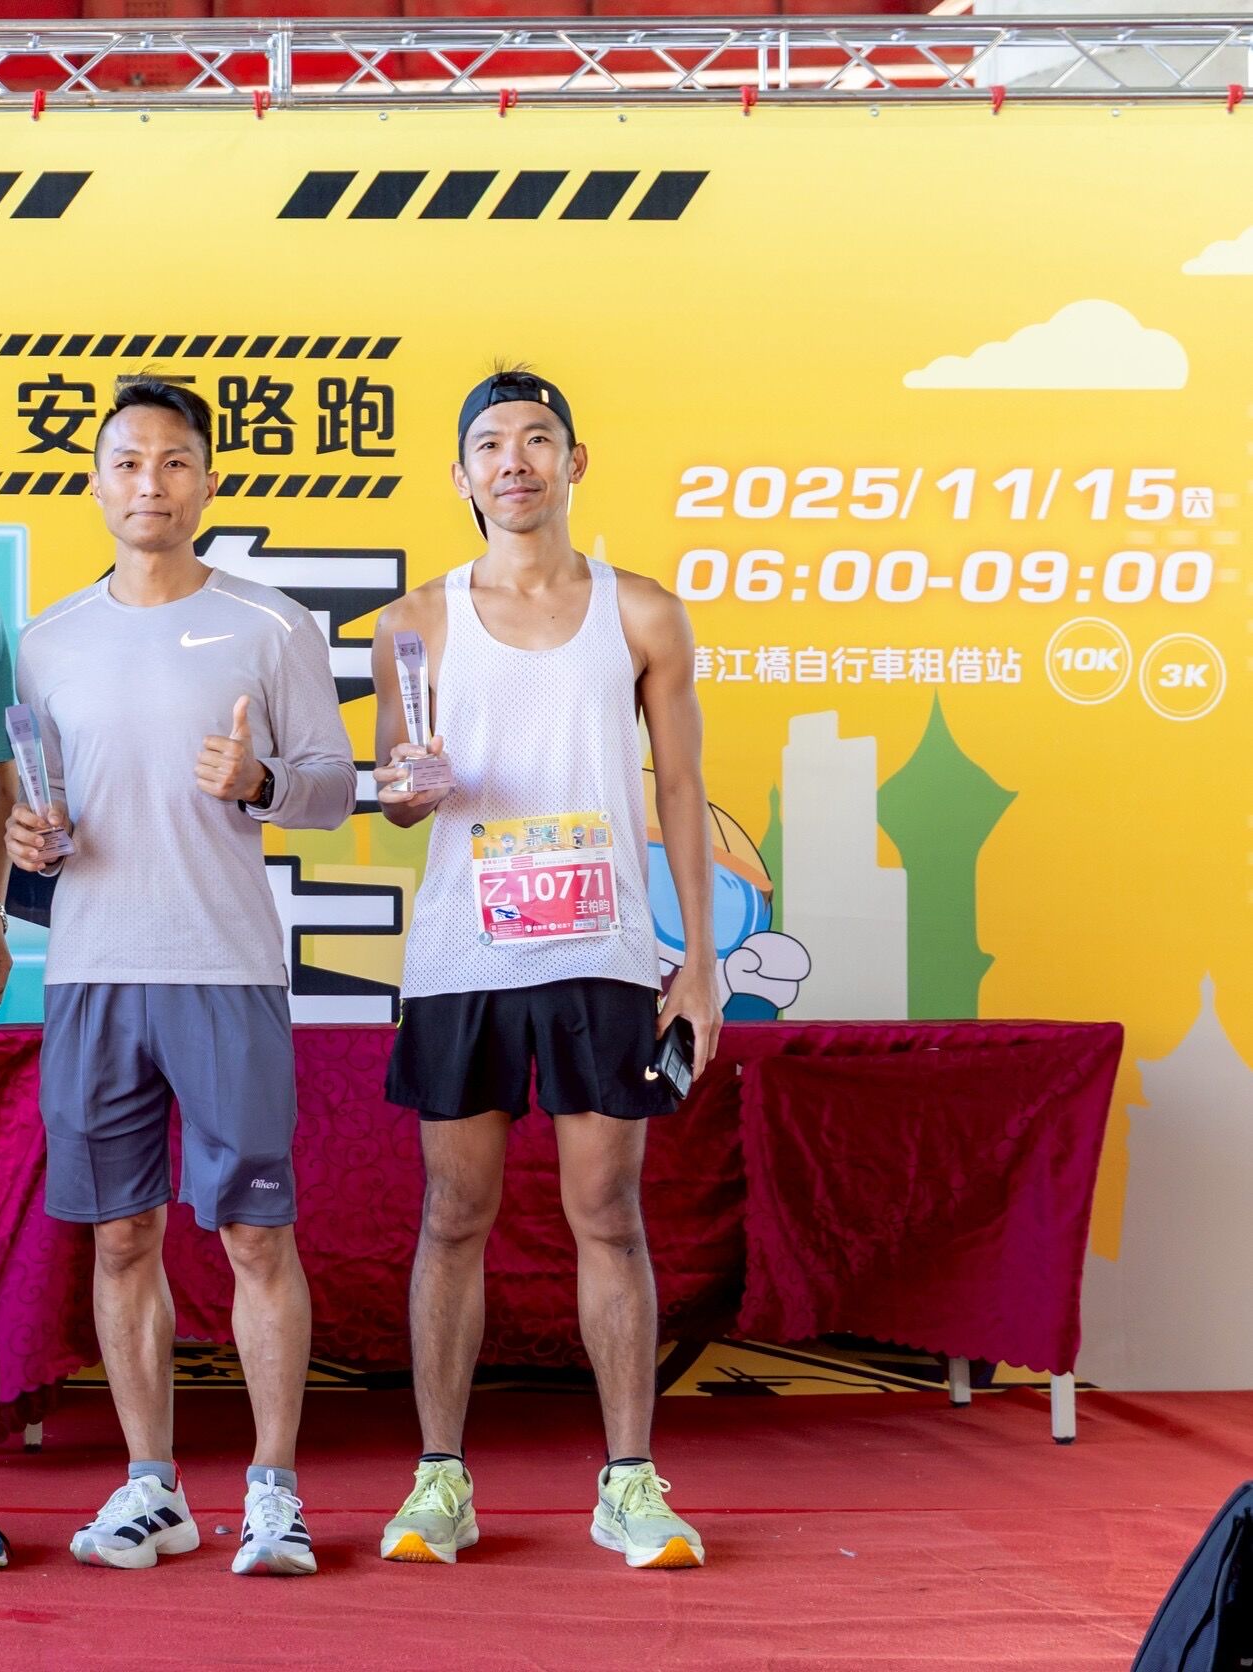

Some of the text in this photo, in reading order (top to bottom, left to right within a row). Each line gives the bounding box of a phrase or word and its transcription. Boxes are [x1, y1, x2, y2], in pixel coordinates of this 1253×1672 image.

[675, 465, 1177, 521] 2025/11/15
[675, 549, 1214, 604] 06:00-09:00
[1055, 647, 1122, 672] 10K
[1158, 663, 1210, 688] 3K
